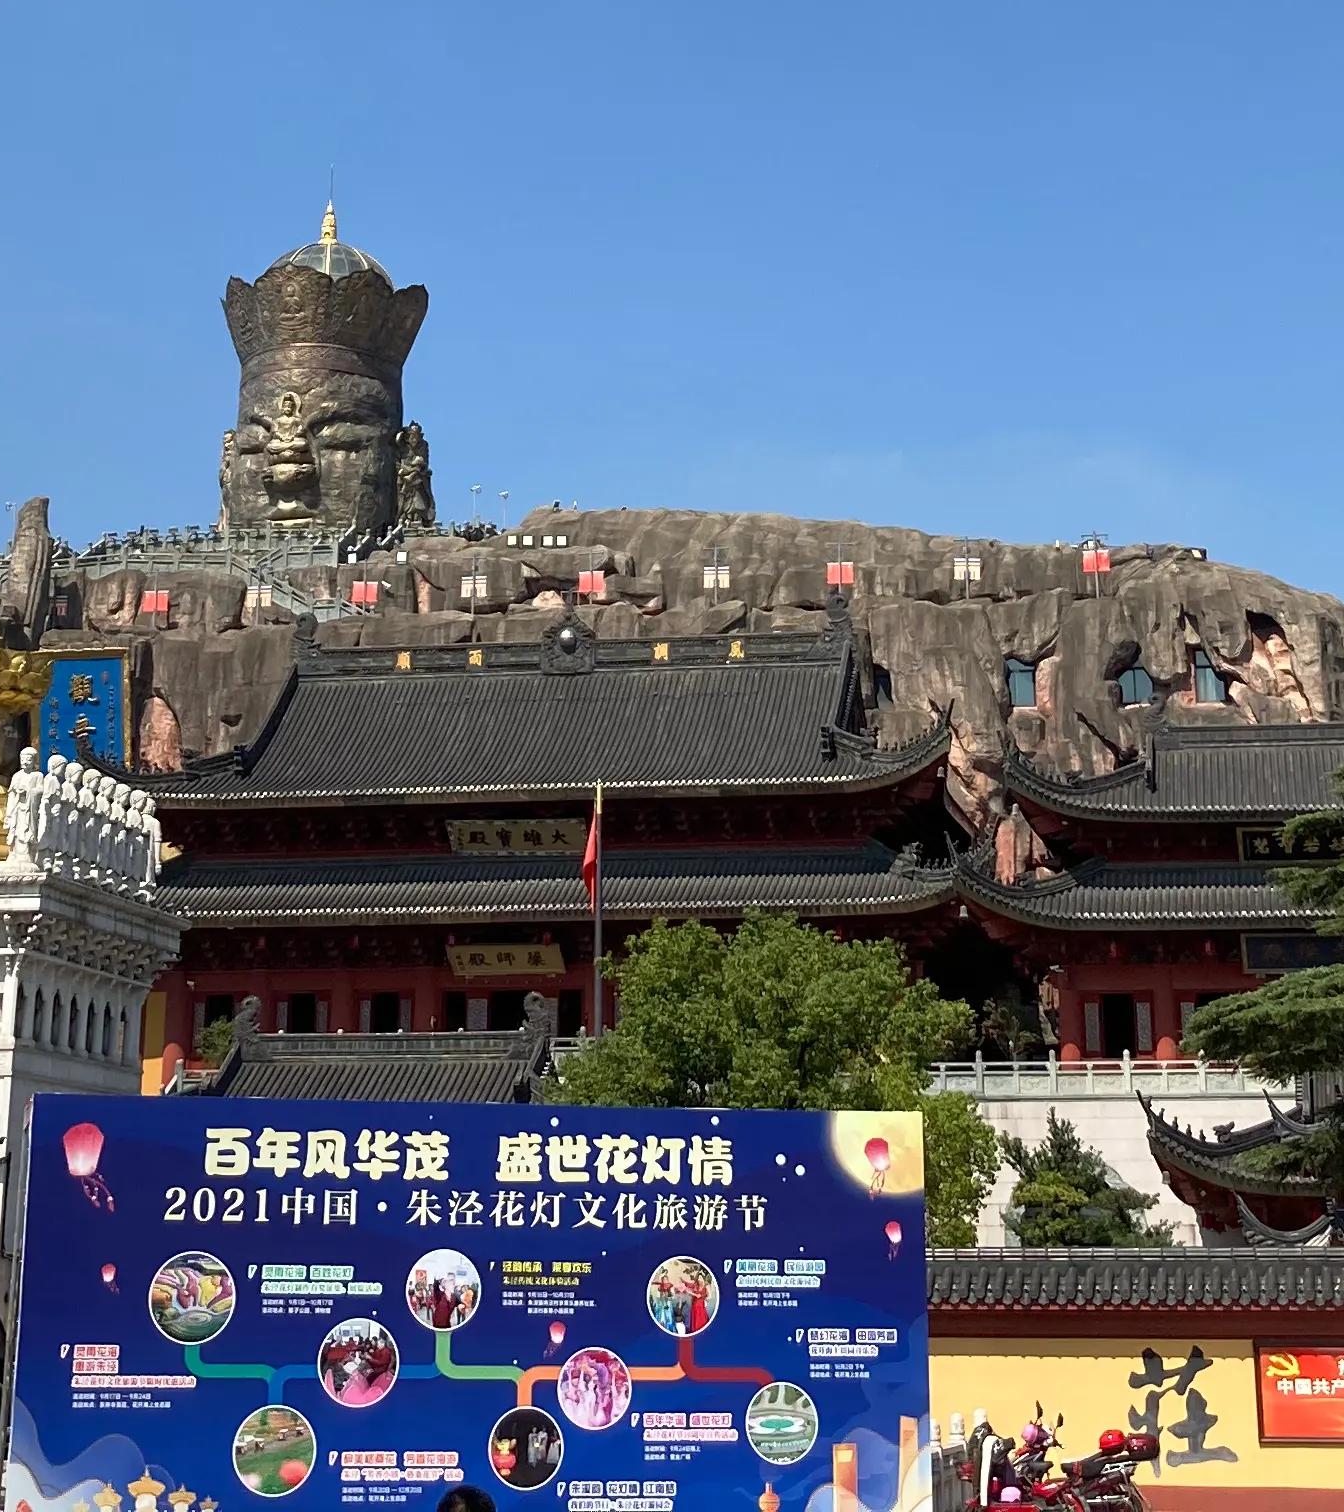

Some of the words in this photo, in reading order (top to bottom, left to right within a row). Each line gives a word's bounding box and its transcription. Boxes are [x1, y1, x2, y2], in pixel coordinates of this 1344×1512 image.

[204, 1127, 451, 1181] 百年风华茂
[494, 1131, 735, 1186] 盛世花灯情
